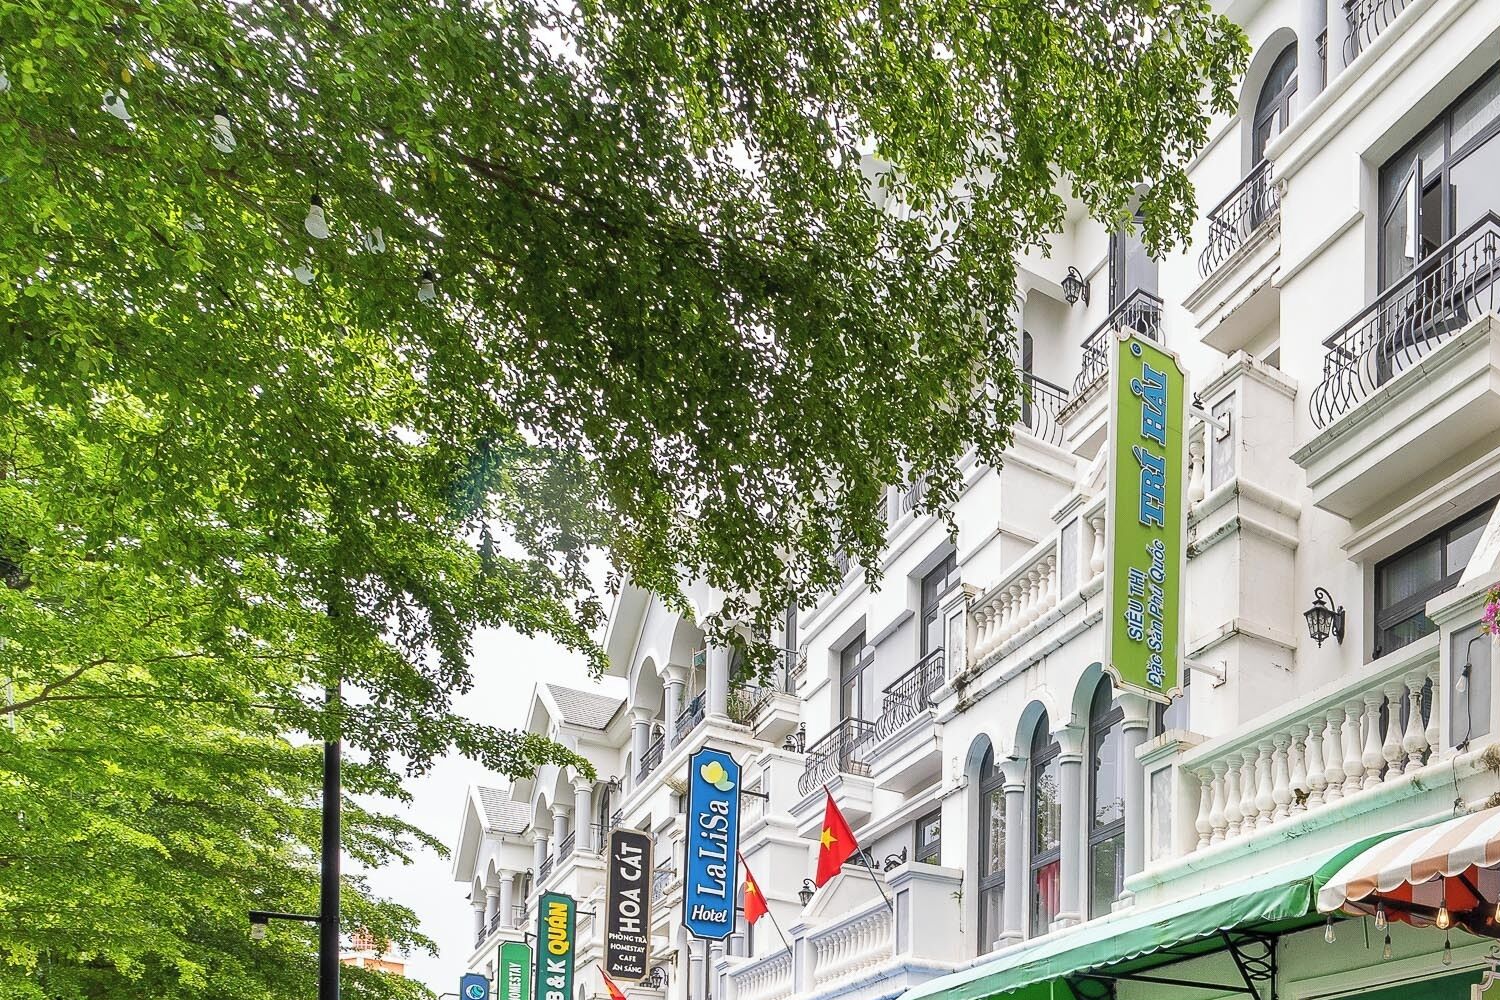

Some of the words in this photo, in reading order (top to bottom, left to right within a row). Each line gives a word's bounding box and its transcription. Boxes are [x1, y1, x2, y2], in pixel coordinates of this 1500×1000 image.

[1130, 362, 1168, 447] HẢI
[1132, 444, 1167, 529] TRÍ
[1128, 566, 1149, 598] THỊ
[1146, 538, 1166, 584] Quốc
[1124, 599, 1145, 642] SIÊU
[615, 841, 643, 882] CÁT
[696, 799, 730, 899] LaLiSa
[543, 901, 570, 956] QUÁN
[618, 888, 642, 932] HOA
[691, 904, 728, 923] Hotel
[608, 931, 634, 942] PHÒNG
[634, 935, 648, 944] TRÀ
[610, 943, 645, 953] HOMESTAY
[618, 954, 637, 962] CAFE
[623, 964, 642, 974] SÁNG
